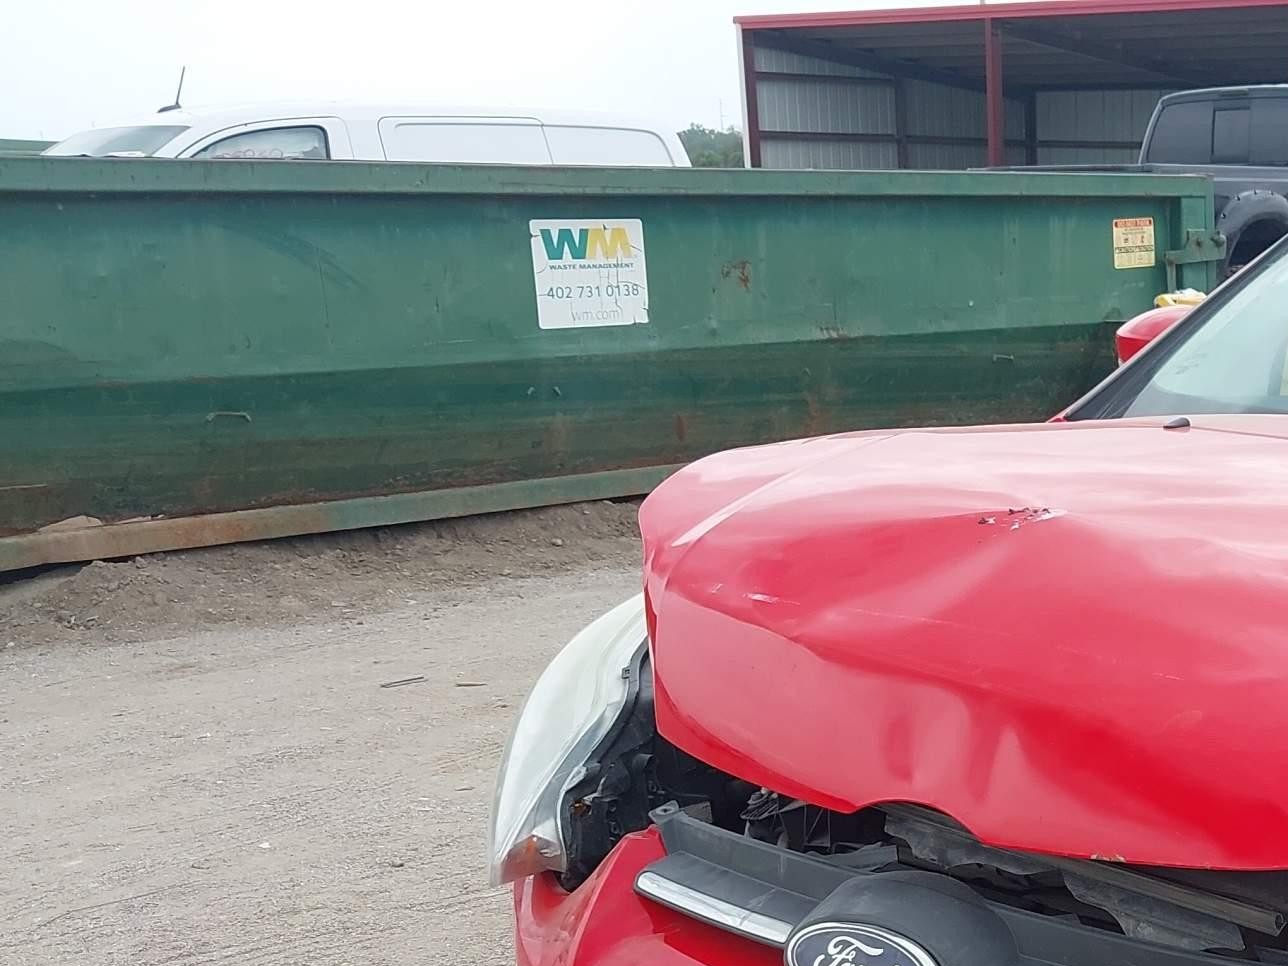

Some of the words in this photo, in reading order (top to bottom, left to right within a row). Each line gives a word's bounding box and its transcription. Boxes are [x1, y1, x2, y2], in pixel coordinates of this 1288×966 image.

[540, 228, 633, 260] WM
[547, 286, 573, 299] 402
[577, 285, 600, 298] 731
[606, 284, 640, 298] 0138
